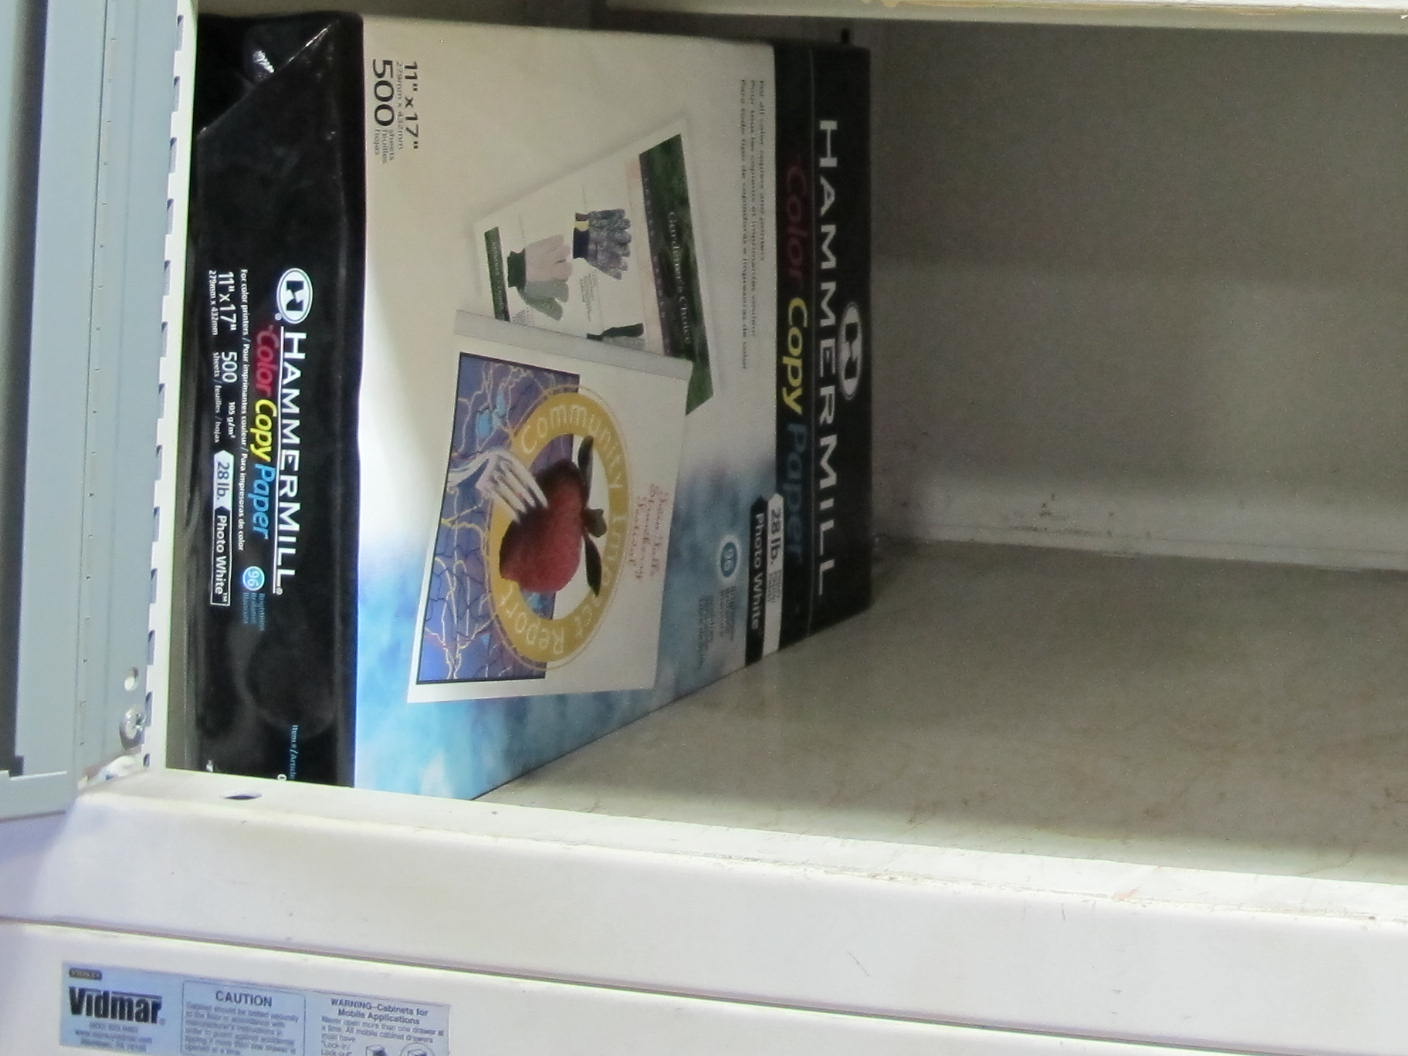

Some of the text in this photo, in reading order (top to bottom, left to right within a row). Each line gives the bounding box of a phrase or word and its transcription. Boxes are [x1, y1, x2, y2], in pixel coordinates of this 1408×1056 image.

[373, 59, 395, 127] 500
[208, 270, 217, 299] 279mm
[209, 306, 219, 336] 432mm
[222, 351, 238, 383] 500
[781, 163, 809, 554] Color Copy Paper
[819, 119, 838, 596] HAMMERMILL
[212, 352, 222, 444] sheets feuilles hojas
[228, 401, 236, 415] 105
[237, 269, 251, 551] For color printers Pour imprimantes couleur Para impresoras de color
[247, 326, 281, 540] Color Copy Paper
[521, 404, 624, 489] Community
[276, 331, 307, 587] HAMMERMILL
[216, 461, 230, 501] 28 lb.
[216, 514, 228, 553] Photo
[770, 508, 781, 534] 28
[770, 537, 781, 565] lb.
[247, 570, 260, 587] 96
[751, 512, 765, 631] Photo White
[498, 583, 564, 654] Report
[69, 986, 163, 1024] Vidmar
[215, 990, 273, 1008] CAUTION
[337, 1008, 421, 1025] Mobile Applications
[416, 1007, 429, 1016] for
